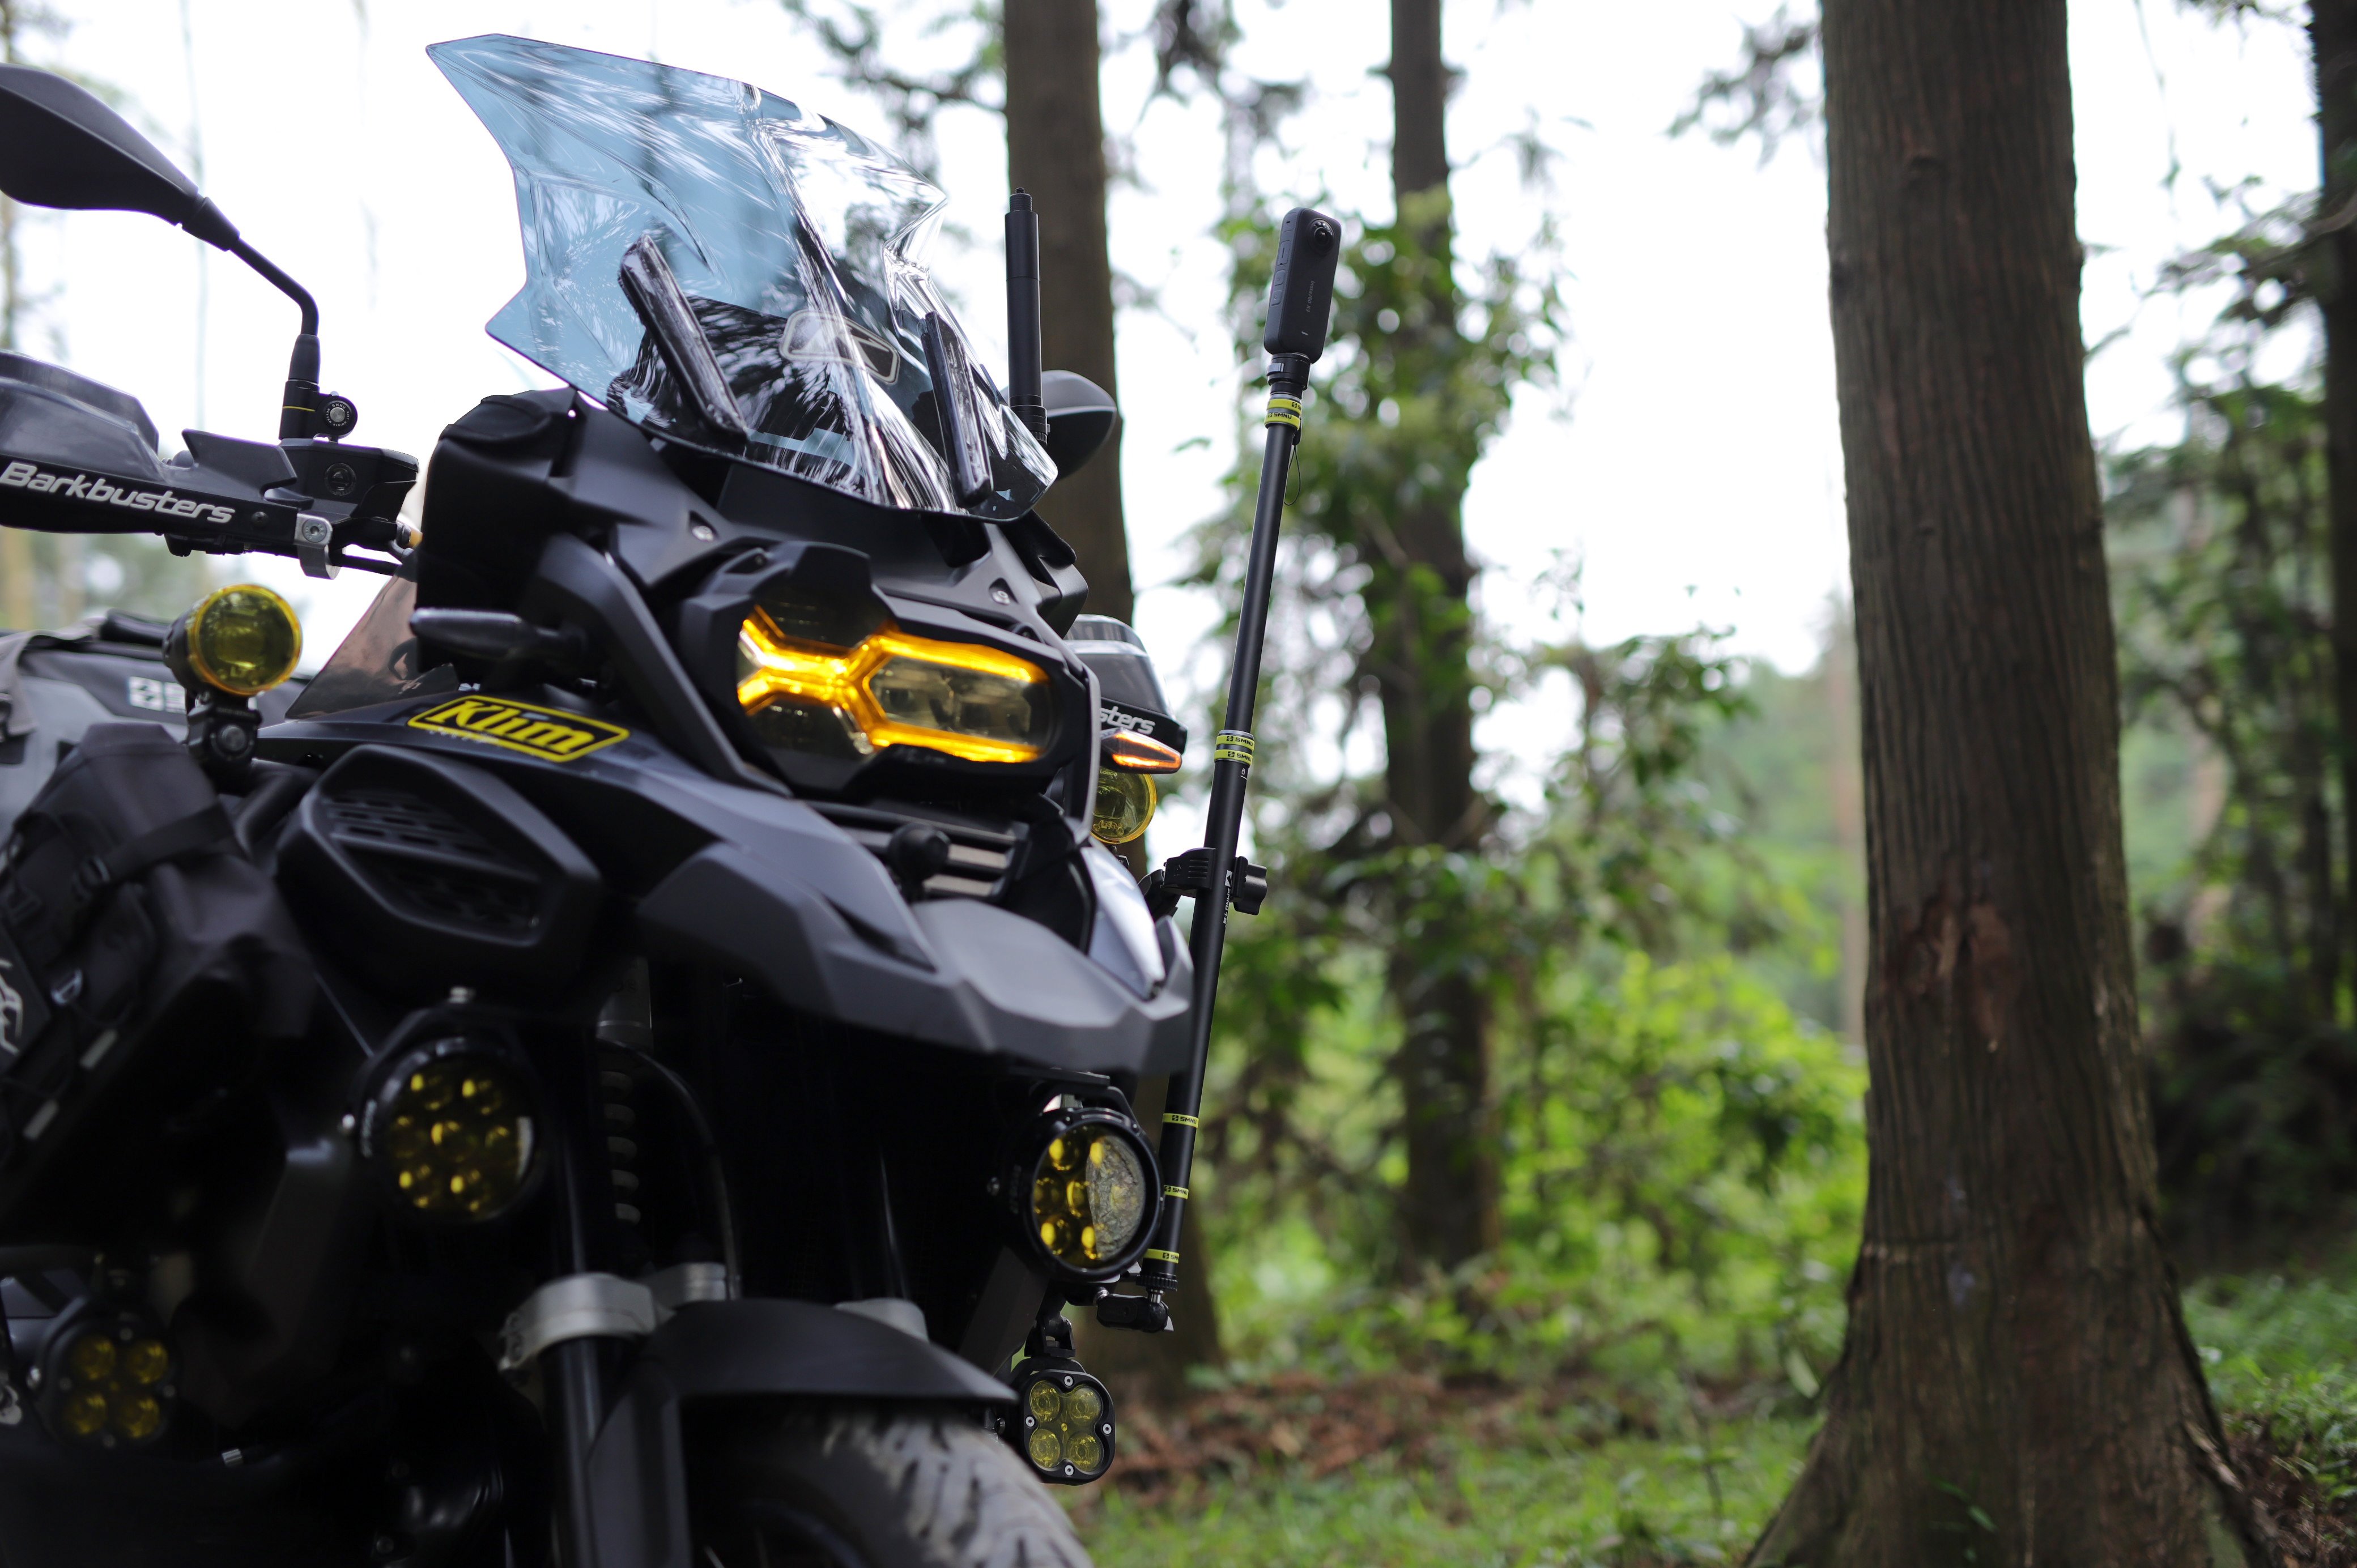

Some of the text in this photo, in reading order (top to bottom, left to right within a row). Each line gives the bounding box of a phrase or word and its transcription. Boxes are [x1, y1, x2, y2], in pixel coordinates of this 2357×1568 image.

[0, 461, 236, 523] Barkbusters
[1235, 737, 1253, 747] SMNU
[1236, 753, 1252, 761] SMNU
